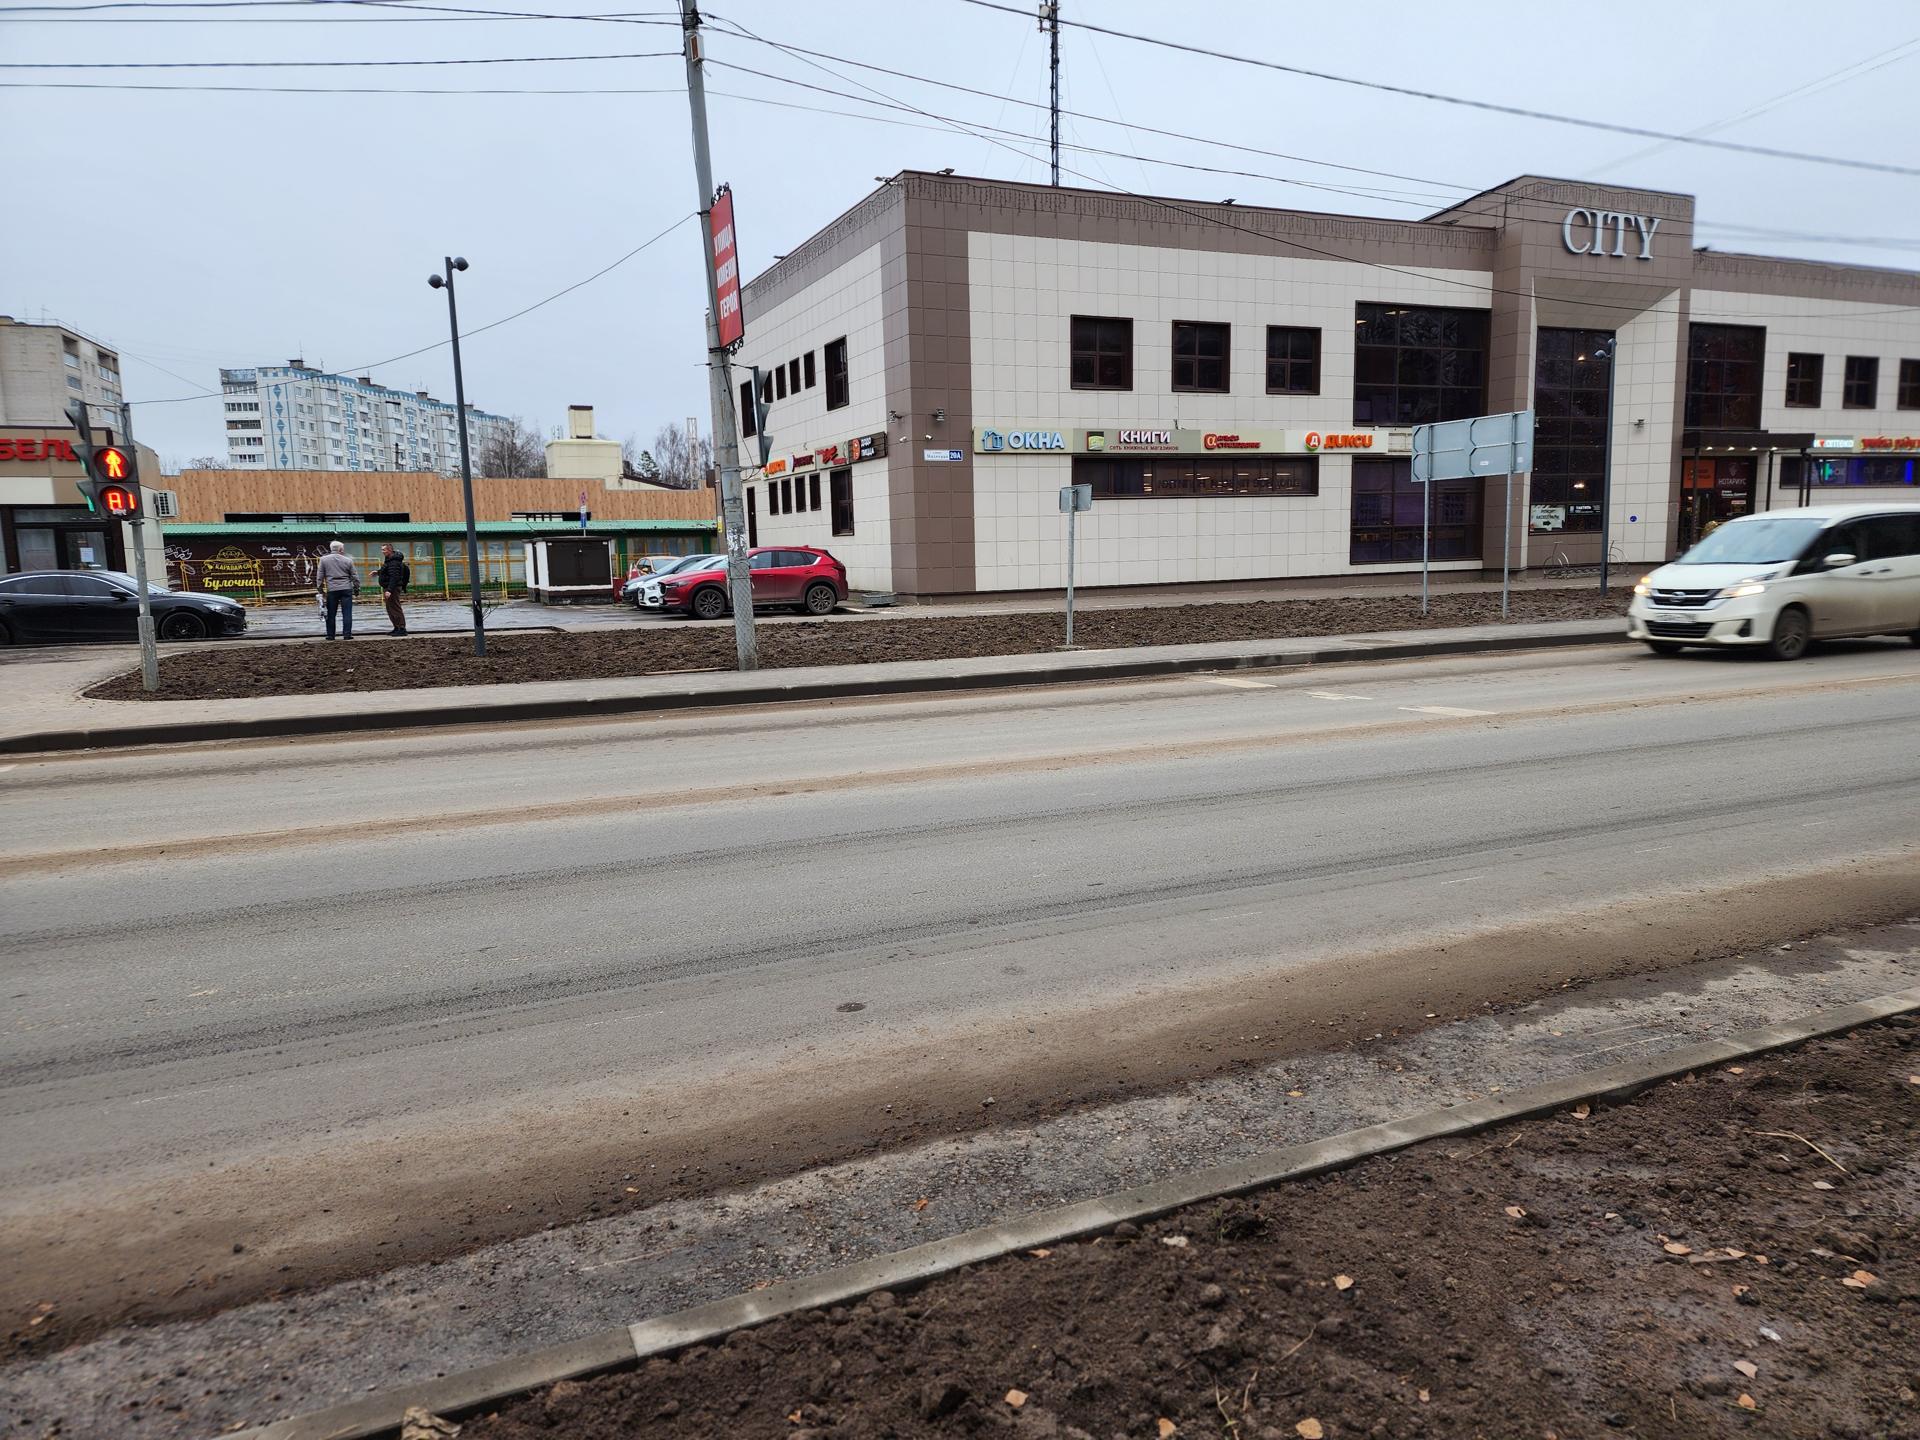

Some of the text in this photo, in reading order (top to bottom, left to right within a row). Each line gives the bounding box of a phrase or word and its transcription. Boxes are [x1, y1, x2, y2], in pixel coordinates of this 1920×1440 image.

[1562, 207, 1662, 260] CITY
[1008, 431, 1065, 450] ОКНА
[1119, 430, 1171, 444] КНИГИ
[202, 577, 265, 590] Булочная
